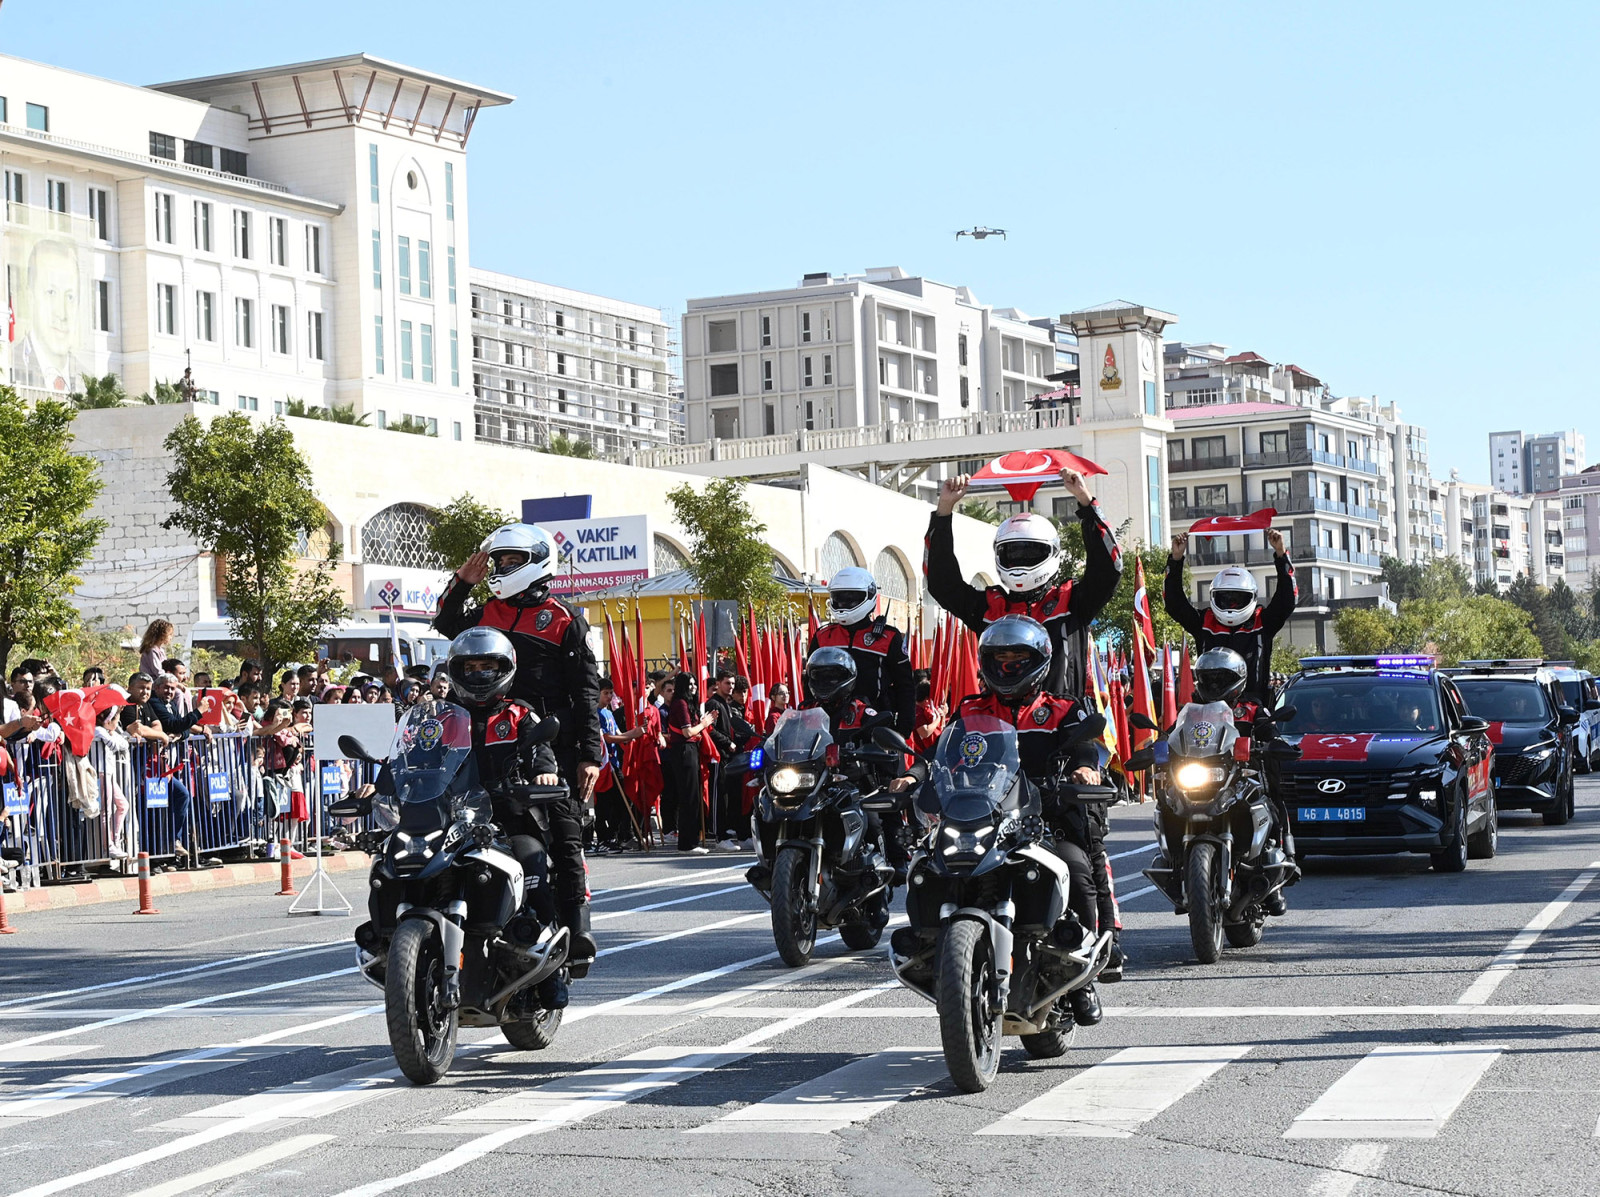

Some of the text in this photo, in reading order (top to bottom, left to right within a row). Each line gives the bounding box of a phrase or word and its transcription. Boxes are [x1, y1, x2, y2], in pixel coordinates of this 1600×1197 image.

[577, 527, 619, 543] VAKIF
[577, 545, 636, 563] KATILIM
[542, 576, 614, 589] AHRAMANMARAŞ
[1304, 808, 1362, 820] 46 A 4815
